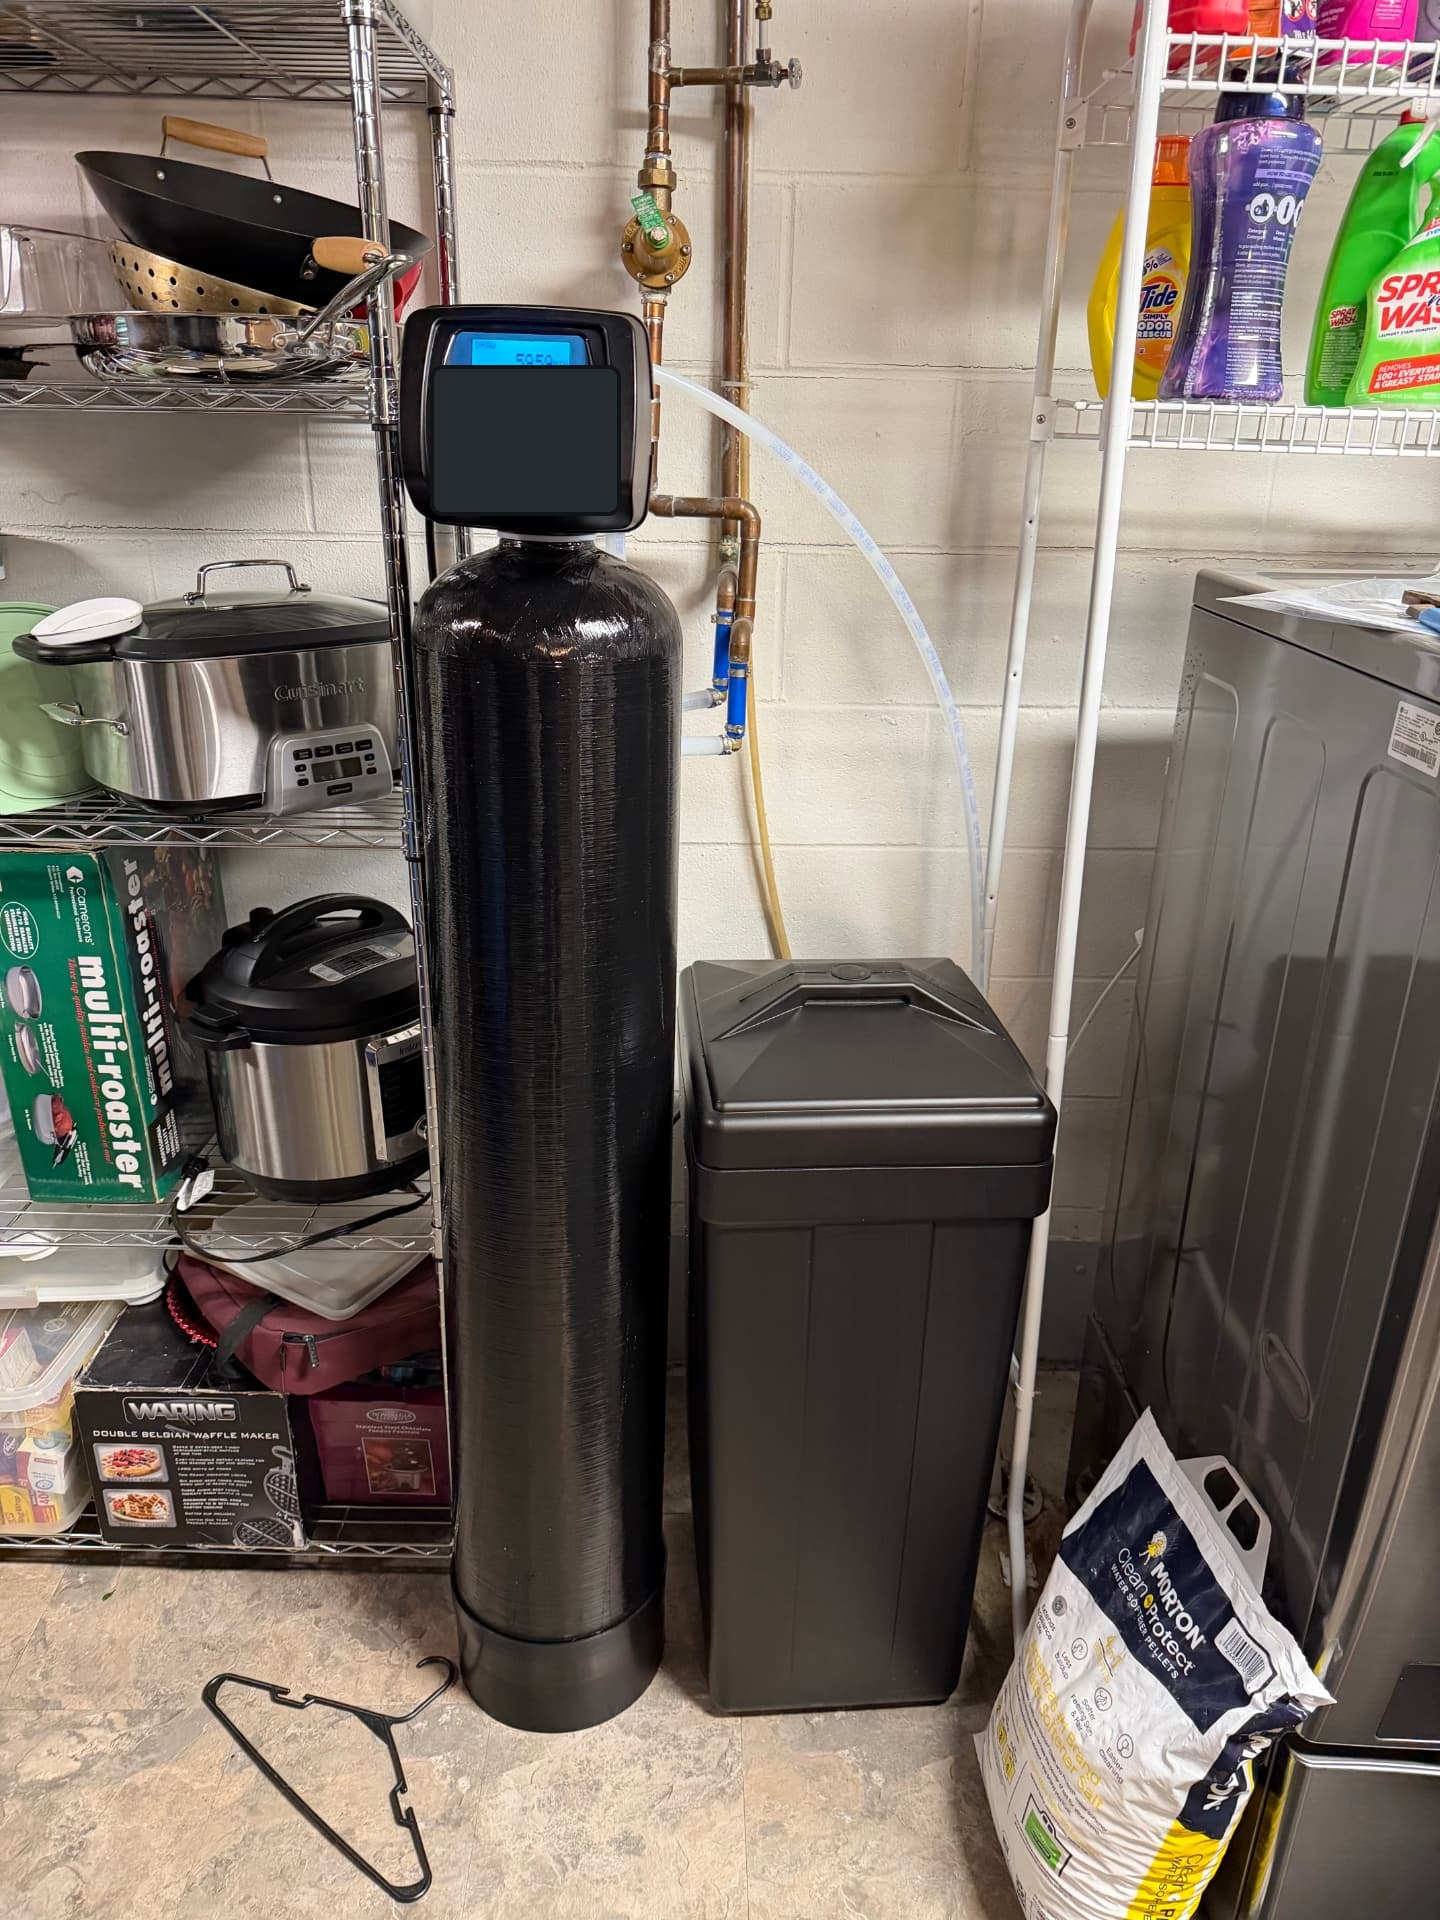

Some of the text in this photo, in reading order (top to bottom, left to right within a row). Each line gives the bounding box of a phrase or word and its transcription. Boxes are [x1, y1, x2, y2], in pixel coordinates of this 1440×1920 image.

[1139, 284, 1178, 313] Tide
[1136, 330, 1173, 338] RESCUE
[1138, 321, 1172, 330] ODOR
[1378, 362, 1412, 372] REMOVES
[1382, 375, 1415, 388] GREASY
[274, 676, 364, 701] Cuisinart
[9, 908, 19, 936] STAINLESS
[76, 887, 93, 943] Camerons
[3, 910, 16, 951] CONSTRUCTION
[25, 926, 34, 950] QUALITY
[123, 858, 173, 1097] multi-roaster
[72, 995, 86, 1022] quality
[78, 956, 142, 1189] multi-roaster
[127, 1402, 236, 1423] WARING
[93, 1430, 280, 1440] DOUBLE BELGIAN WAFFLE MAKER
[1116, 1546, 1195, 1676] Clean Protect
[1149, 1561, 1204, 1650] MORTON
[1111, 1563, 1179, 1679] WATER SOFTENER PELLETS
[1060, 1651, 1071, 1668] Less
[1069, 1693, 1086, 1721] Feeling
[1079, 1698, 1098, 1720] Softer
[1039, 1703, 1077, 1774] Softener
[1078, 1775, 1104, 1809] Salt
[1067, 1732, 1102, 1786] Brand
[1098, 1748, 1123, 1785] Cleaning
[1105, 1747, 1124, 1771] Easier
